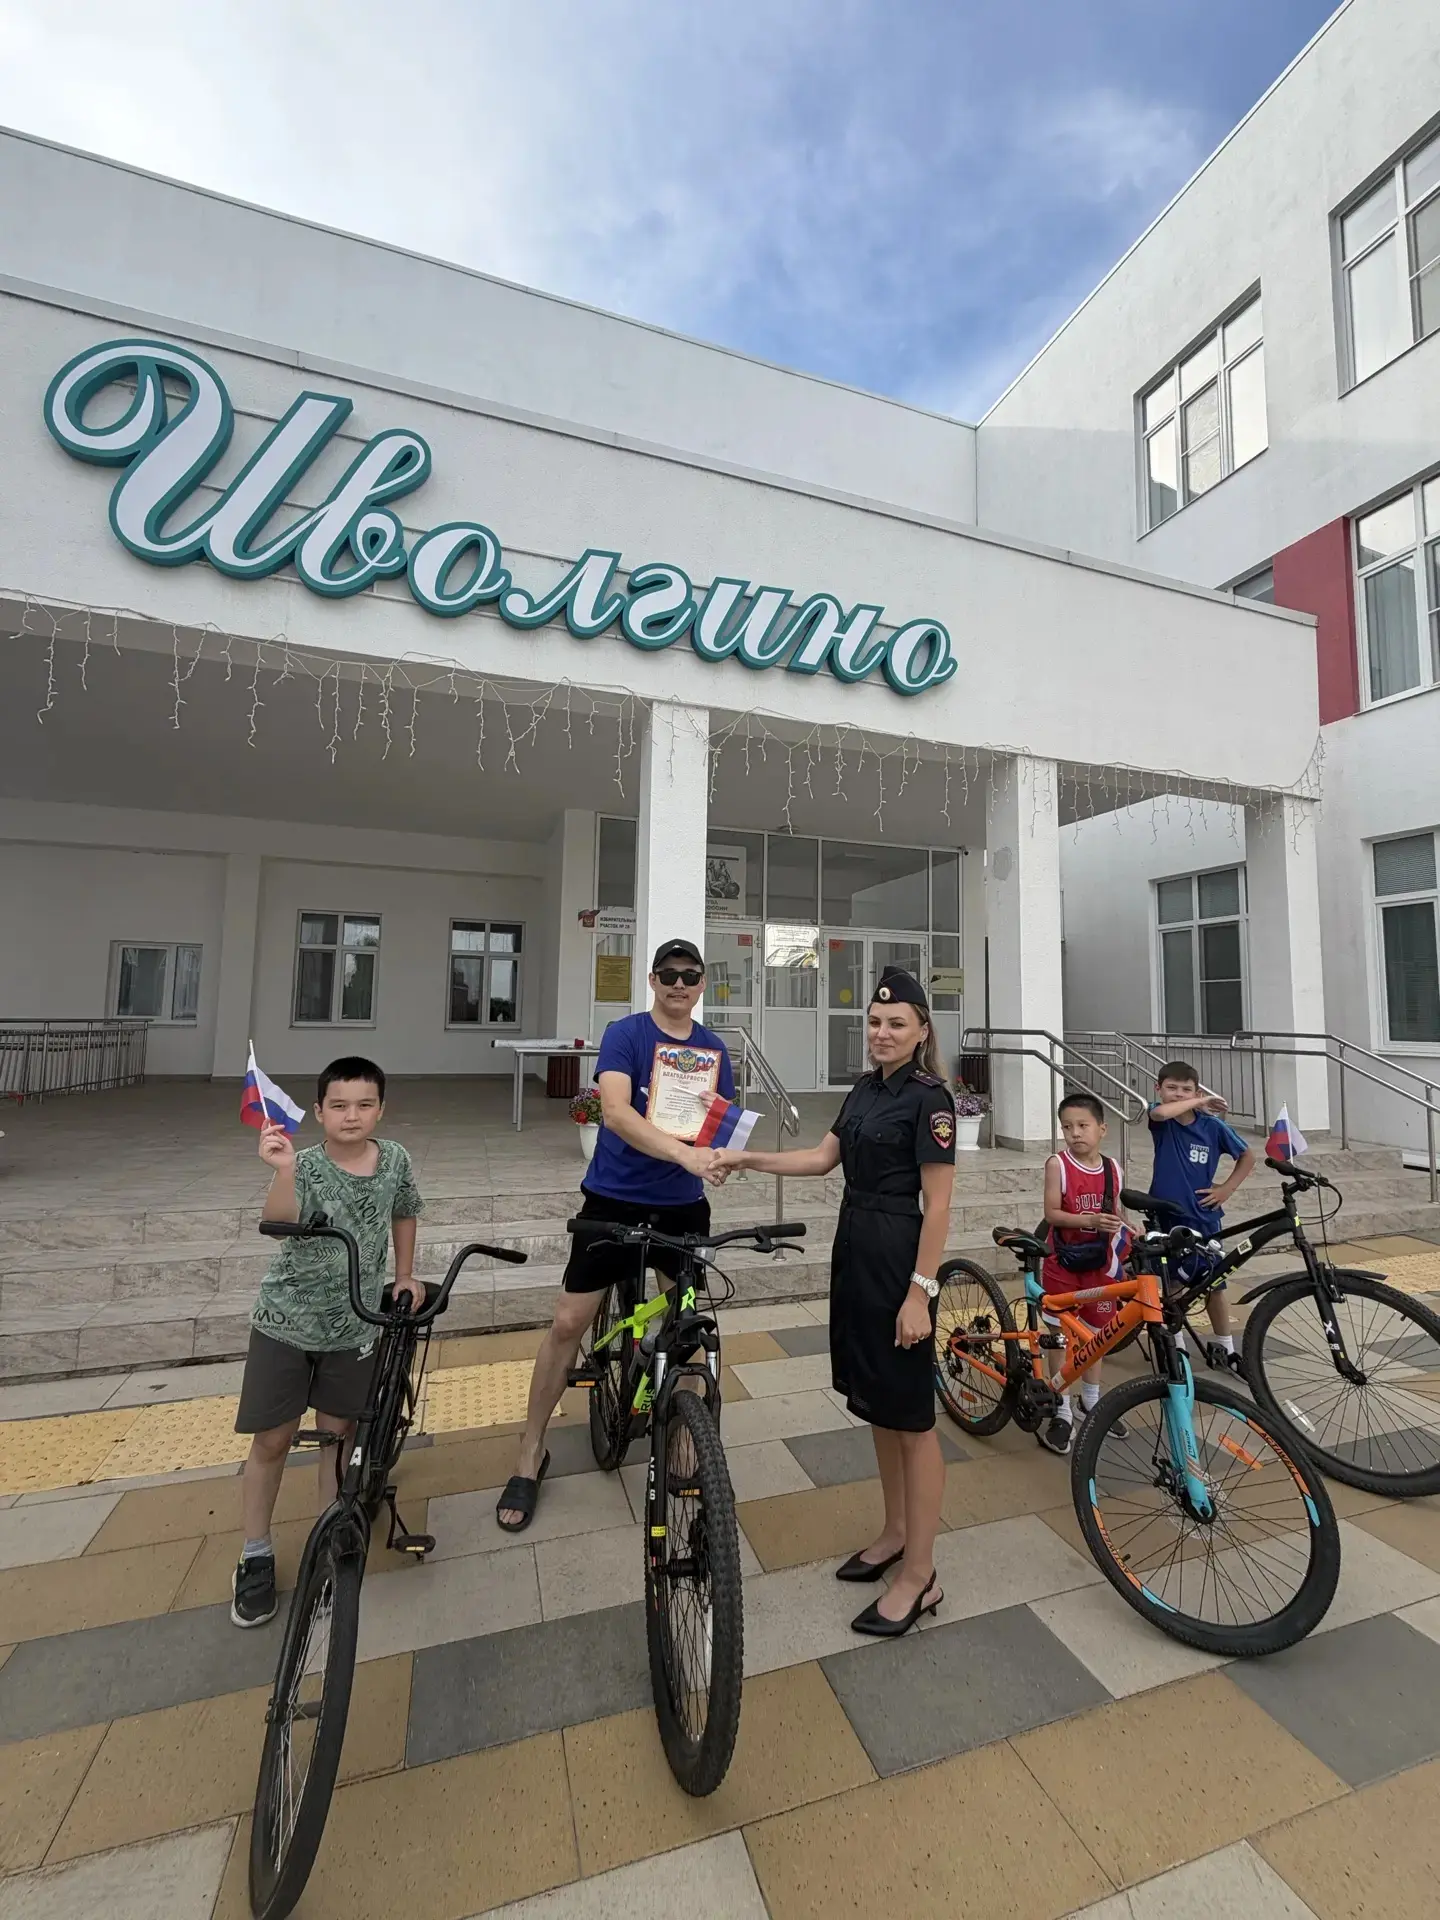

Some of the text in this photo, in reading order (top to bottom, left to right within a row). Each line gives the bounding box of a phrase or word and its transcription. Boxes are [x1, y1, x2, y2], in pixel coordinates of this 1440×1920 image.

[44, 338, 958, 696] Иволгино
[662, 1071, 707, 1082] БЛАГОДАРНОСТЬ
[1189, 1149, 1208, 1164] 98
[1097, 1301, 1112, 1313] 23
[1072, 1314, 1126, 1371] ACTIWELL
[1260, 1431, 1299, 1475] ACTIWELL
